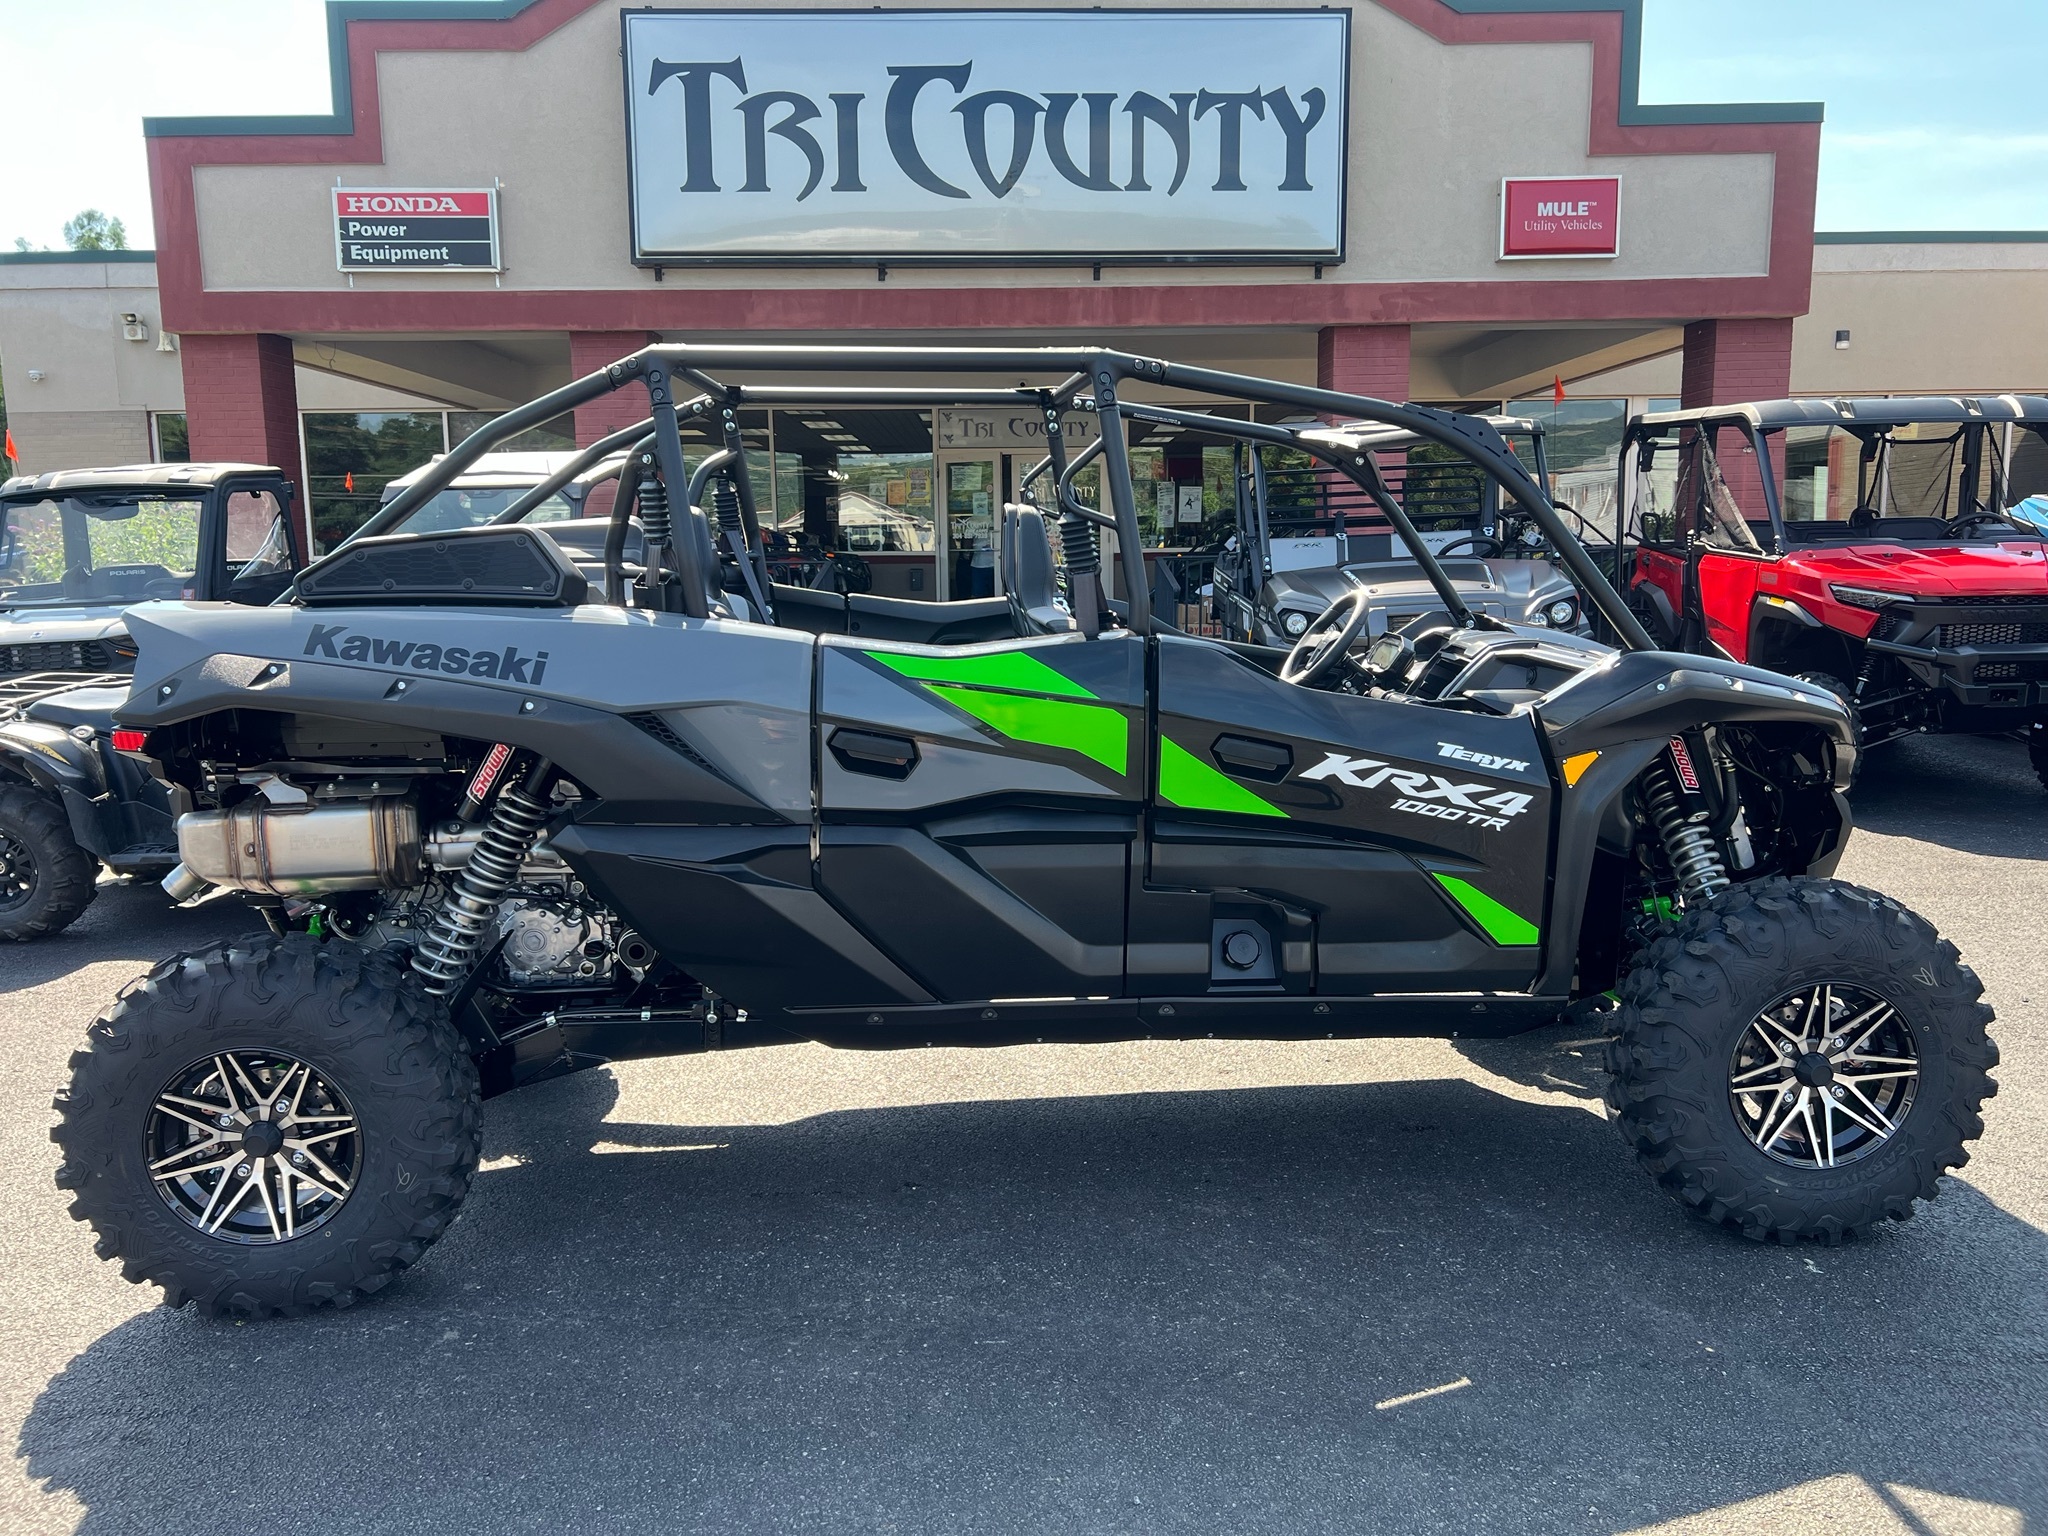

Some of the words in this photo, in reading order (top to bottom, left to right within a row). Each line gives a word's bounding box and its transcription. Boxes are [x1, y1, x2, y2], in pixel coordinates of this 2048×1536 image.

[648, 56, 868, 202] TRI
[885, 59, 1326, 199] COUNTY
[346, 197, 461, 213] HONDA
[348, 221, 407, 237] Power
[1524, 219, 1558, 233] Utility
[1560, 219, 1603, 231] Vehicles
[350, 245, 449, 263] Equipment
[303, 623, 549, 686] Kawasaki
[472, 743, 510, 800] SHOWA
[1298, 752, 1534, 817] KRX4
[1669, 739, 1699, 788] SHOWA
